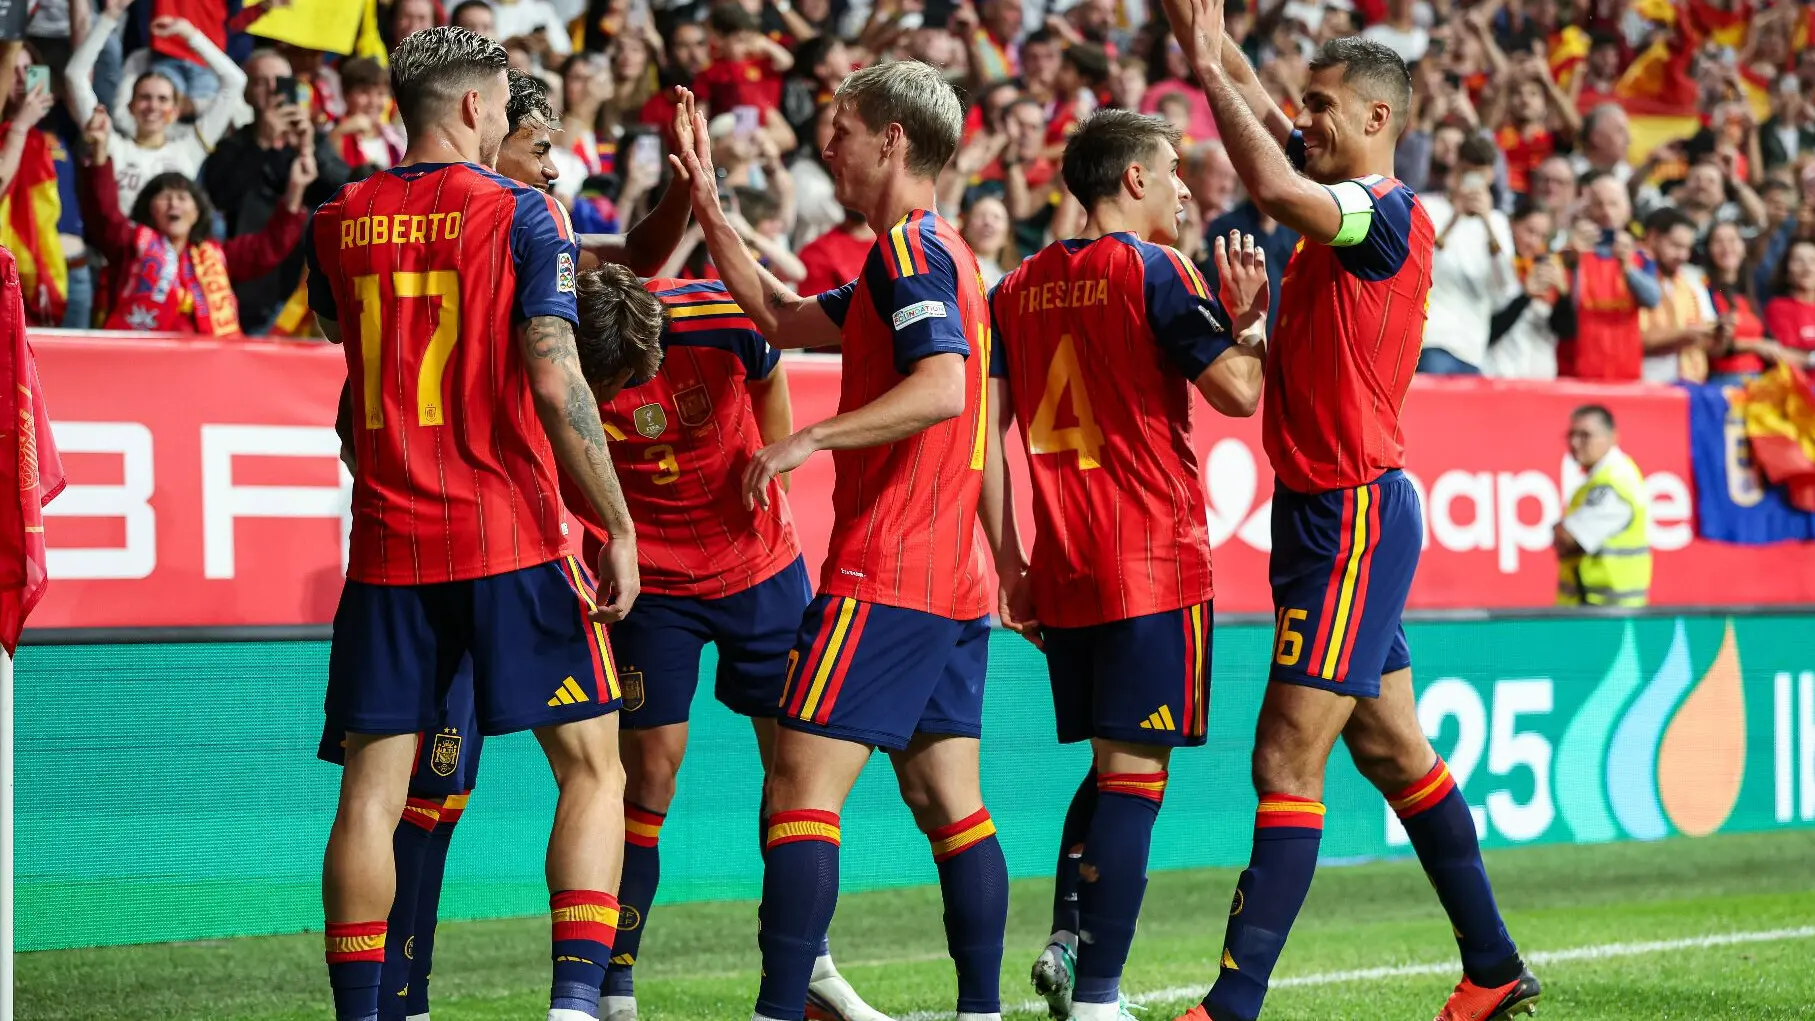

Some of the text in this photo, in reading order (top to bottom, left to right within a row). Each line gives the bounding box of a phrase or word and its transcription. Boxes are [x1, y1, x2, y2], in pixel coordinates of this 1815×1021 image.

[340, 212, 461, 249] ROBERTO
[353, 270, 460, 430] 17
[1029, 334, 1105, 470] 4
[644, 444, 680, 484] 3
[1272, 606, 1308, 666] 16
